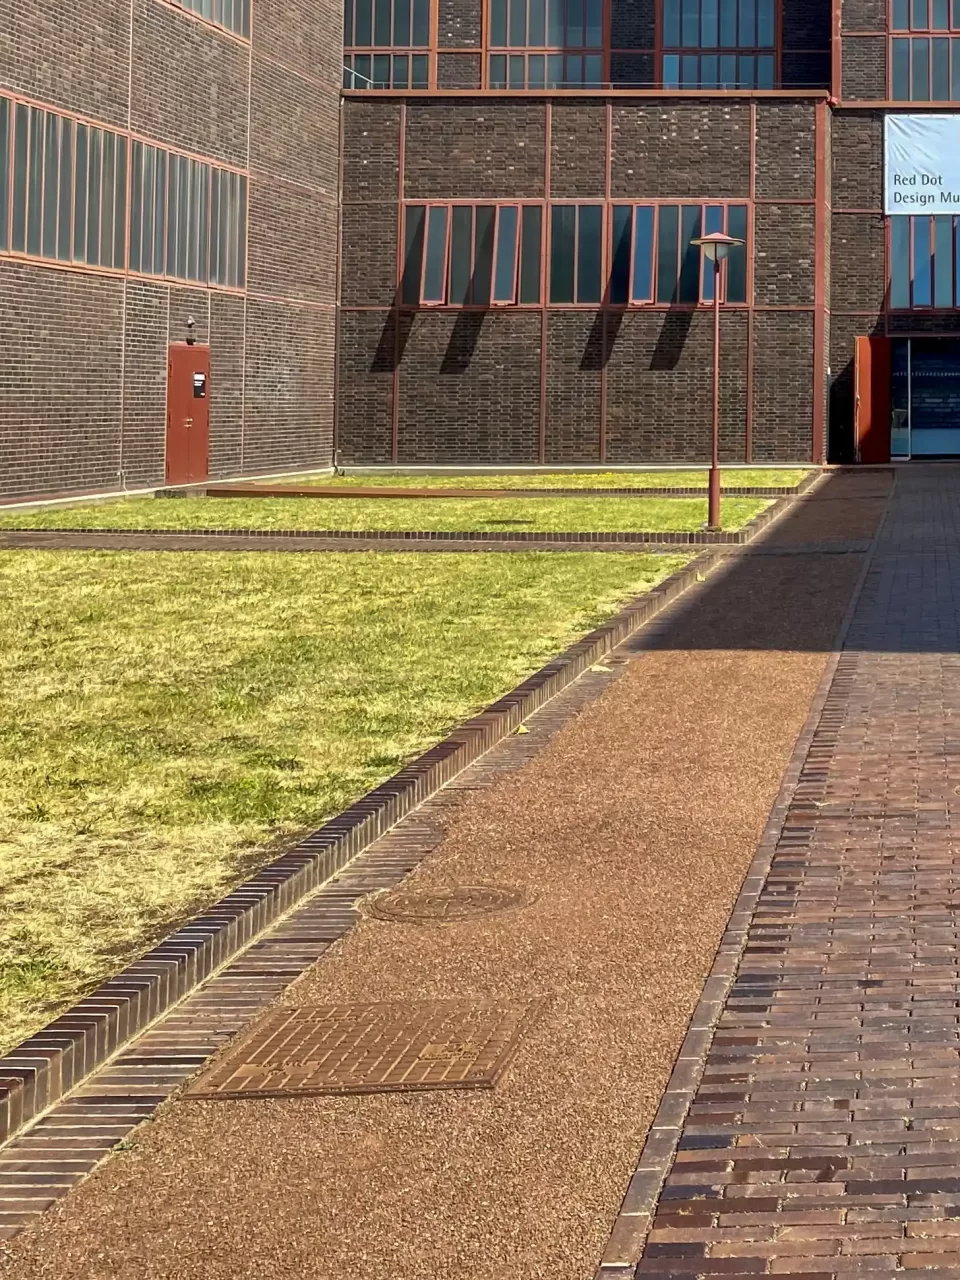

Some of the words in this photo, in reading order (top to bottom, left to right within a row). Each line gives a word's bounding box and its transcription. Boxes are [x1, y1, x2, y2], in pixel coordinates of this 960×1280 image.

[894, 174, 916, 185] Red
[921, 174, 943, 185] Dot
[894, 192, 935, 206] Design
